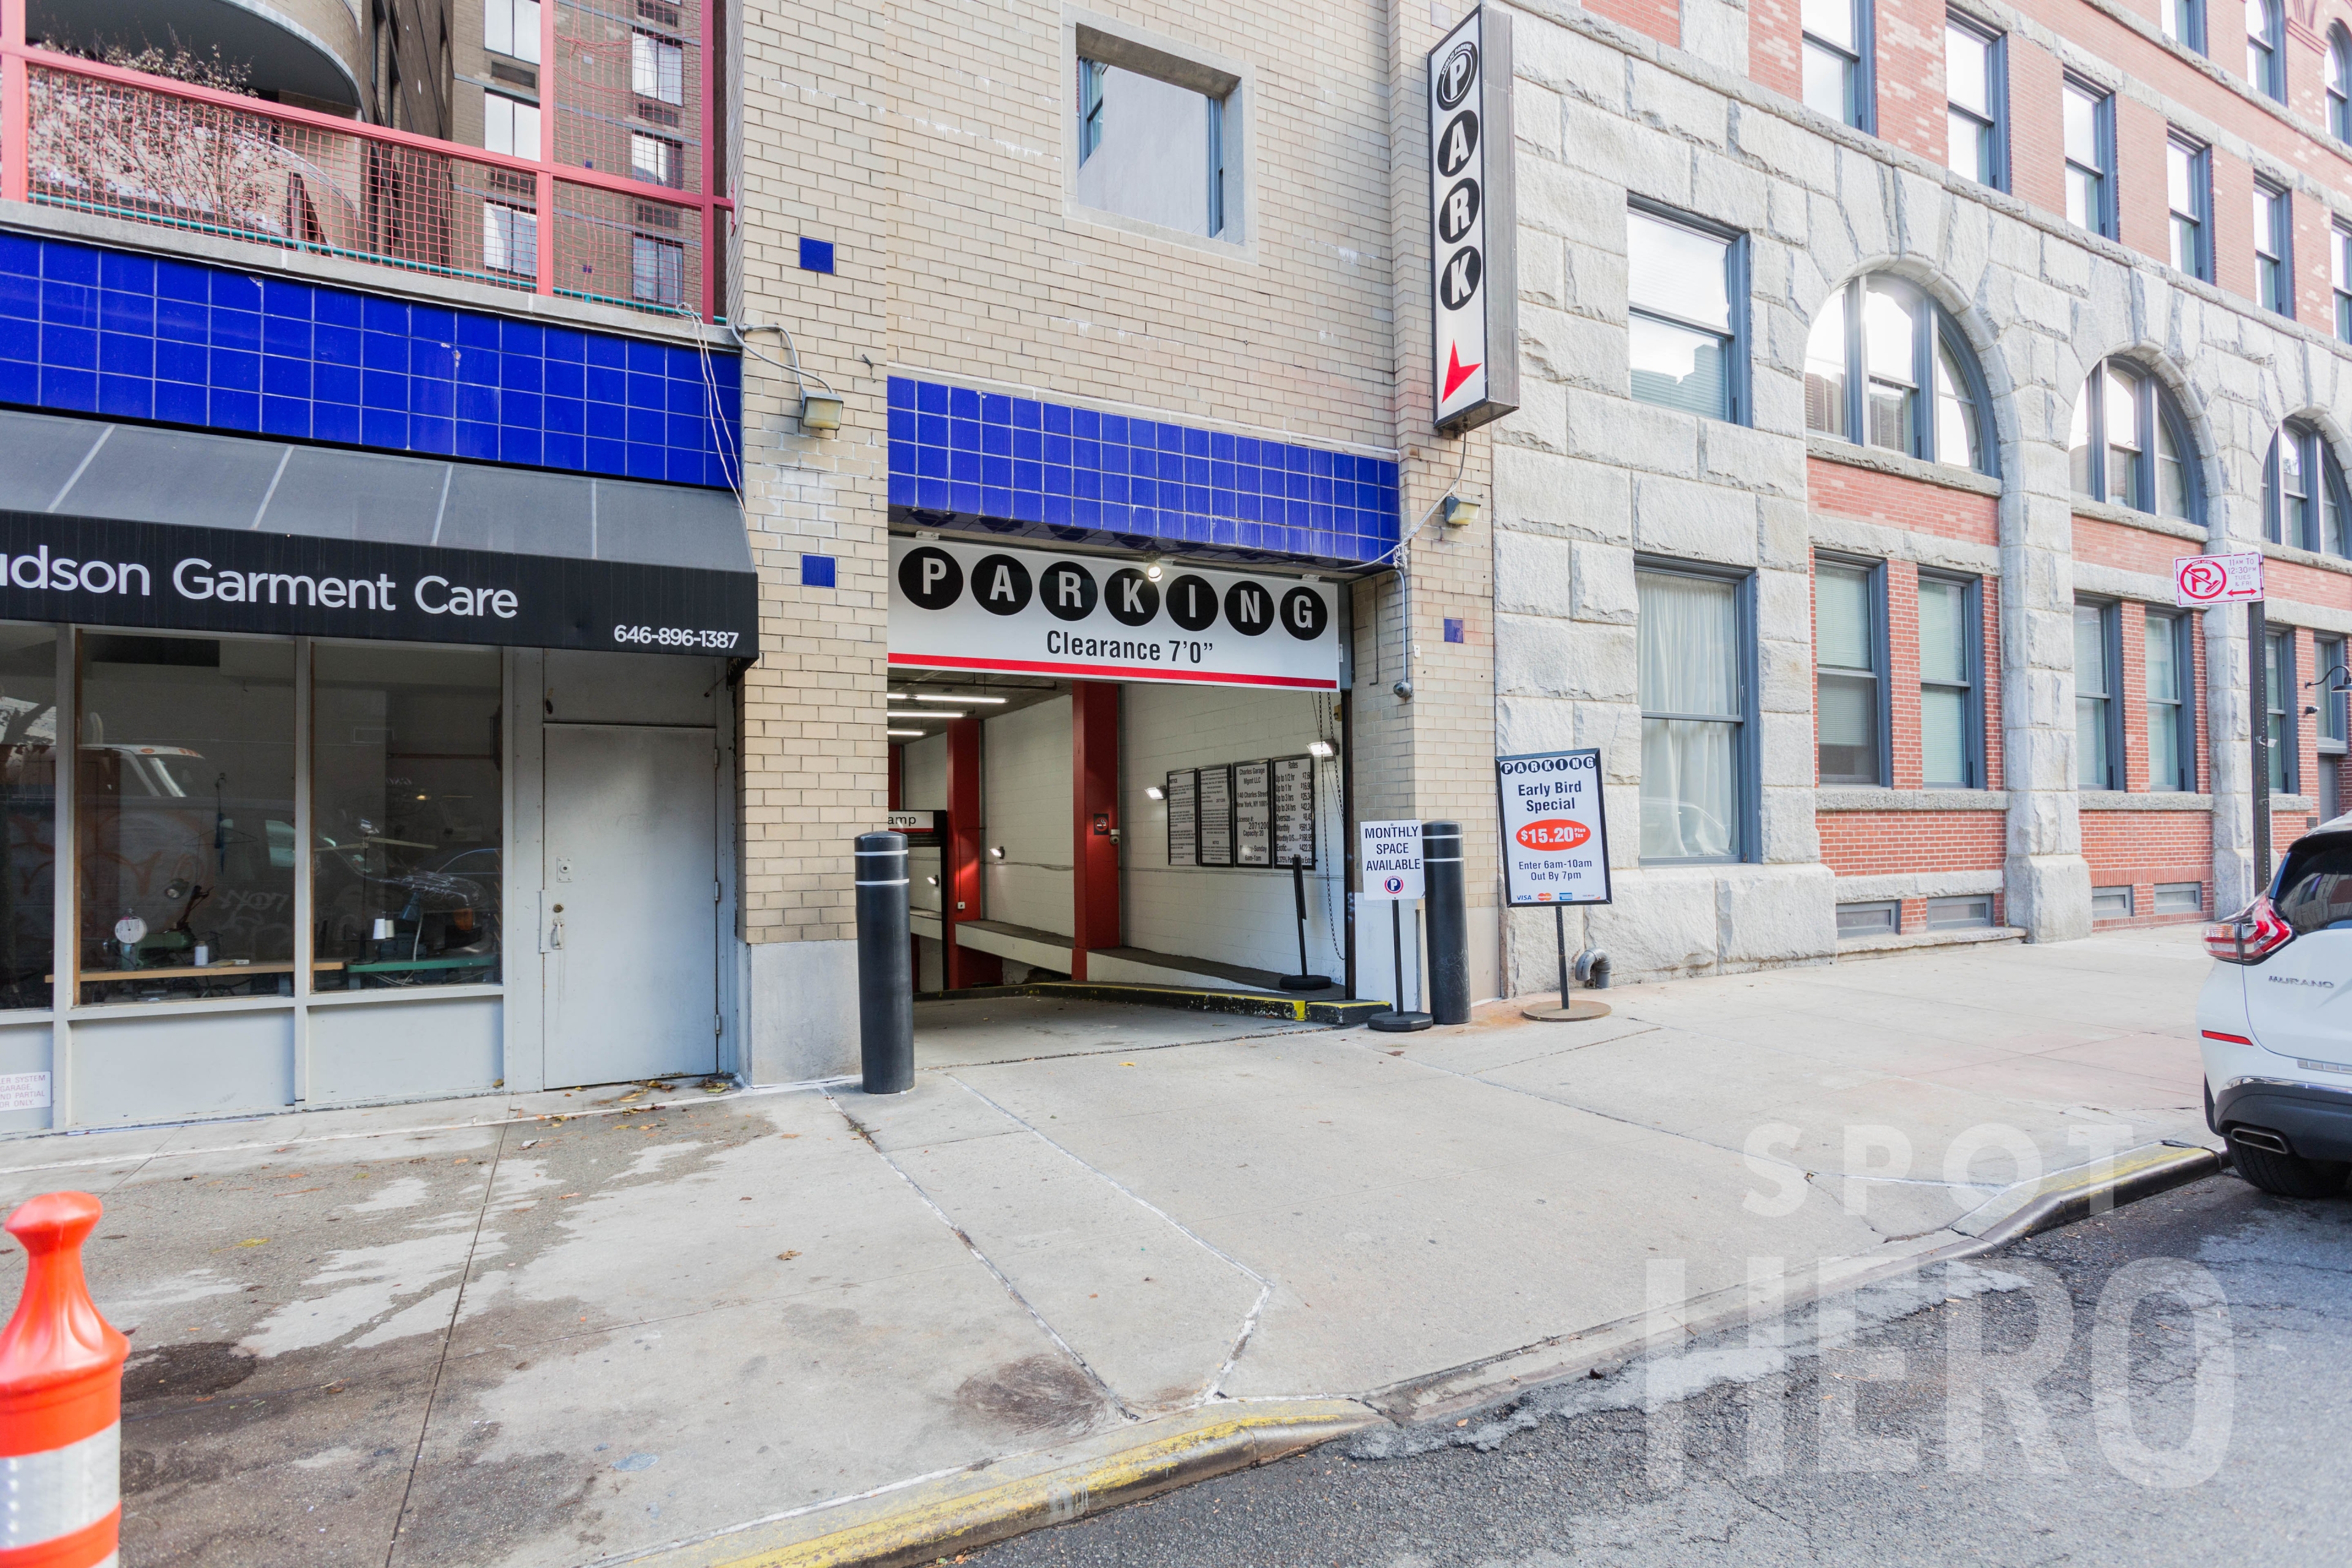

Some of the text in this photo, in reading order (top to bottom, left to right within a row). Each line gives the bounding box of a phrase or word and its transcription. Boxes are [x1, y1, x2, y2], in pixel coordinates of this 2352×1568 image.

[1441, 53, 1455, 75] PUBLIC
[0, 545, 518, 619] dson Garment Care
[922, 556, 1313, 629] PARKING
[613, 625, 739, 649] 646-896-1387
[1047, 630, 1161, 662] Clearance
[1504, 757, 1594, 774] PARKING
[1275, 774, 1280, 783] Up
[1275, 784, 1280, 794] Up
[1518, 780, 1581, 797] Early Bird
[1276, 794, 1281, 804] Up
[1276, 804, 1281, 813] Up
[1526, 797, 1575, 814] Special
[1276, 813, 1290, 822] Oversize
[1276, 824, 1290, 833] Monthly
[1365, 826, 1419, 839] MONTHLY
[1520, 827, 1574, 843] $15.20
[1376, 842, 1409, 854] SPACE
[1366, 858, 1421, 871] AVAILABLE
[1519, 859, 1592, 870] Enter 6am-10am
[1531, 871, 1581, 881] Out By 7pm
[2268, 976, 2334, 989] MURANO
[15, 1074, 46, 1084] SYSTEM
[0, 1084, 32, 1092] GARAGE.
[14, 1099, 34, 1107] ONLY.
